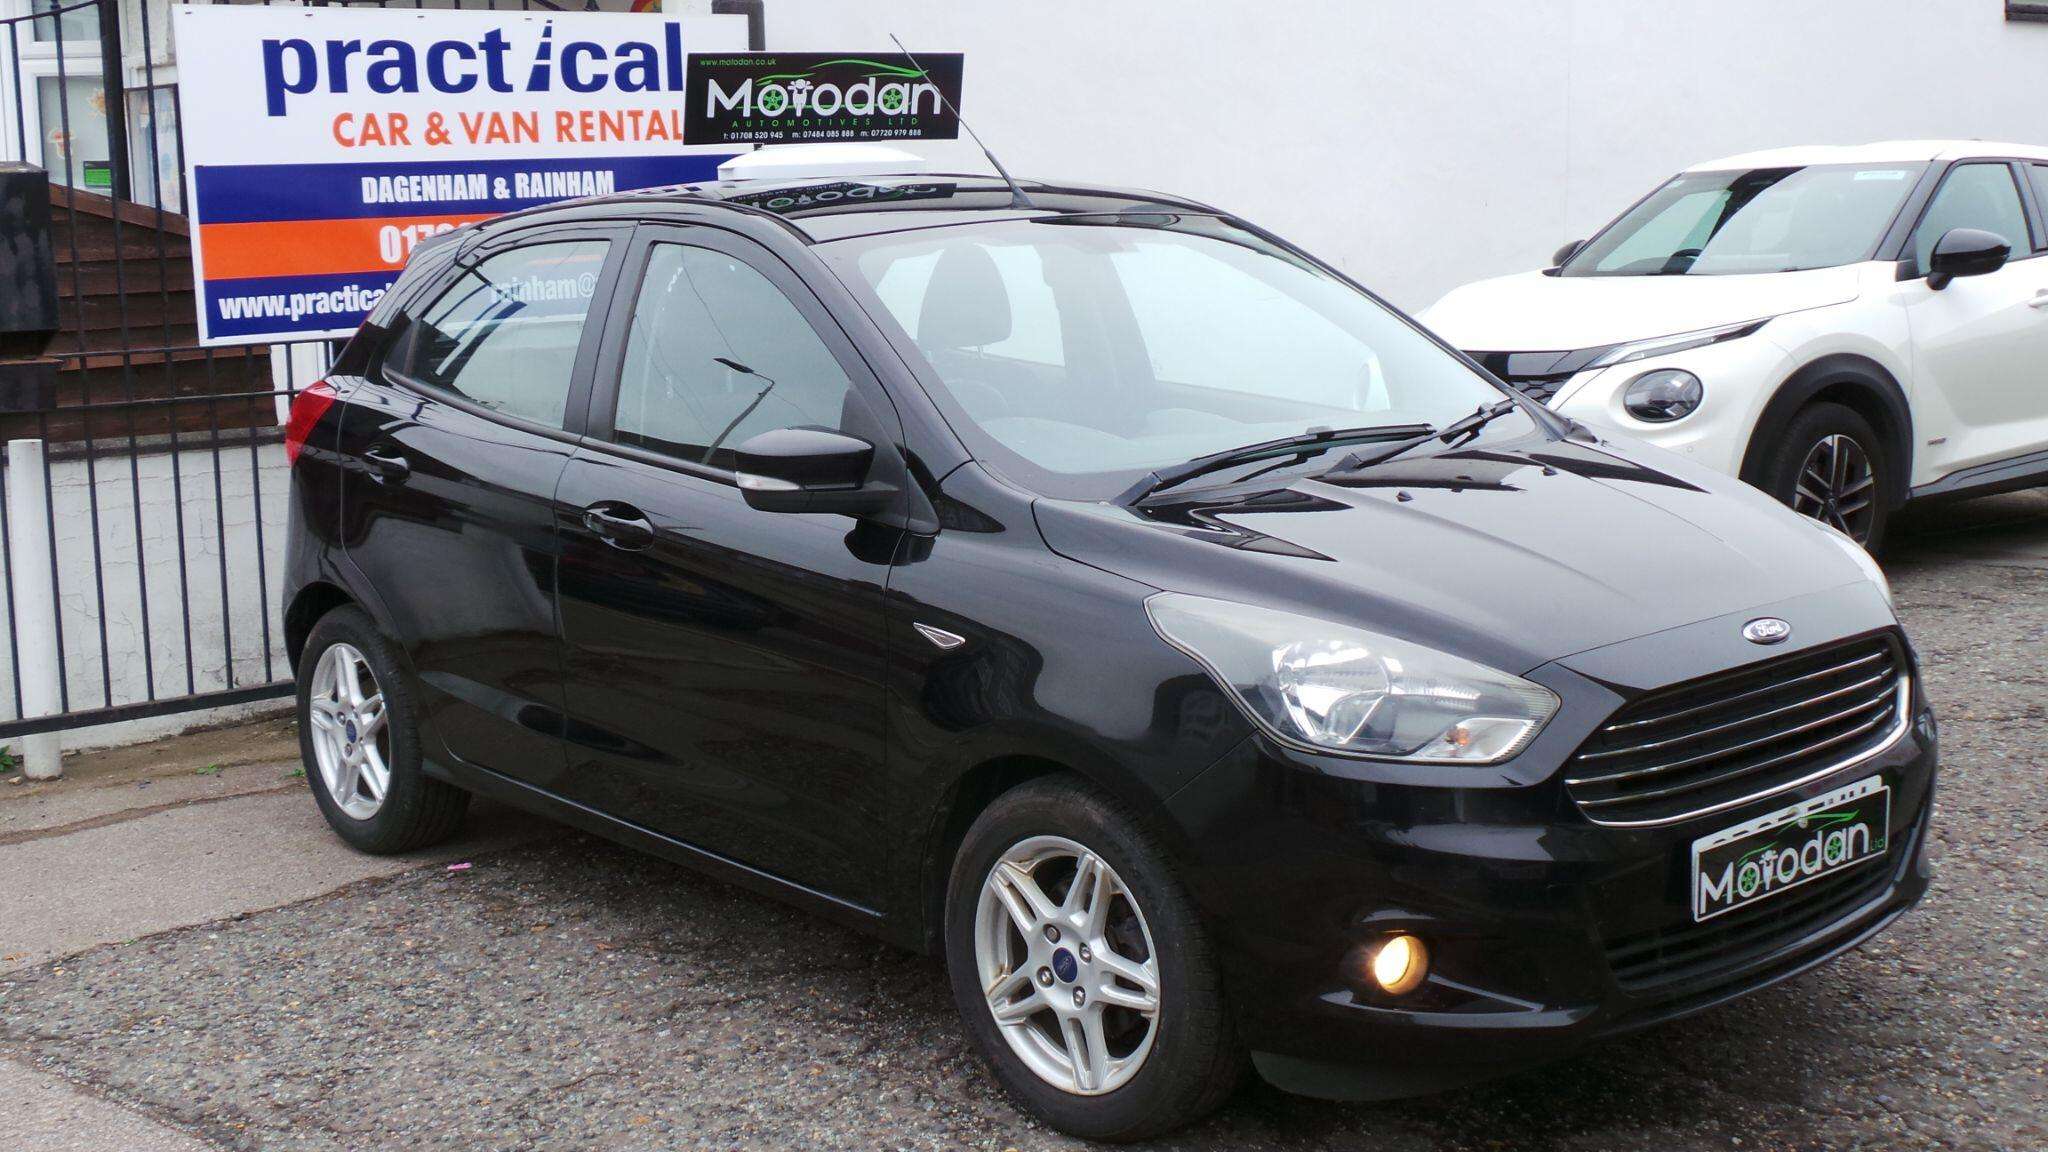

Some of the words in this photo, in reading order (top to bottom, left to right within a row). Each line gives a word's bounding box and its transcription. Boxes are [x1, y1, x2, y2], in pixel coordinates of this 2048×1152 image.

[262, 20, 684, 117] practical
[700, 58, 777, 66] www.motodan.co.uk
[706, 76, 942, 118] Motodan
[332, 111, 412, 147] CAR
[423, 110, 453, 146] &
[458, 110, 539, 145] VAN
[554, 109, 683, 143] RENTAL
[730, 131, 753, 139] 01708
[754, 131, 769, 139] 520
[770, 130, 784, 139] 945
[870, 128, 893, 137] 07720
[732, 118, 871, 128] AUTOMOTIVES
[888, 117, 918, 126] LTD
[361, 173, 488, 204] DAGENHAM
[493, 177, 510, 199] &
[514, 170, 615, 198] RAINHAM
[218, 282, 393, 322] www.practica
[1700, 822, 1870, 914] Motodan
